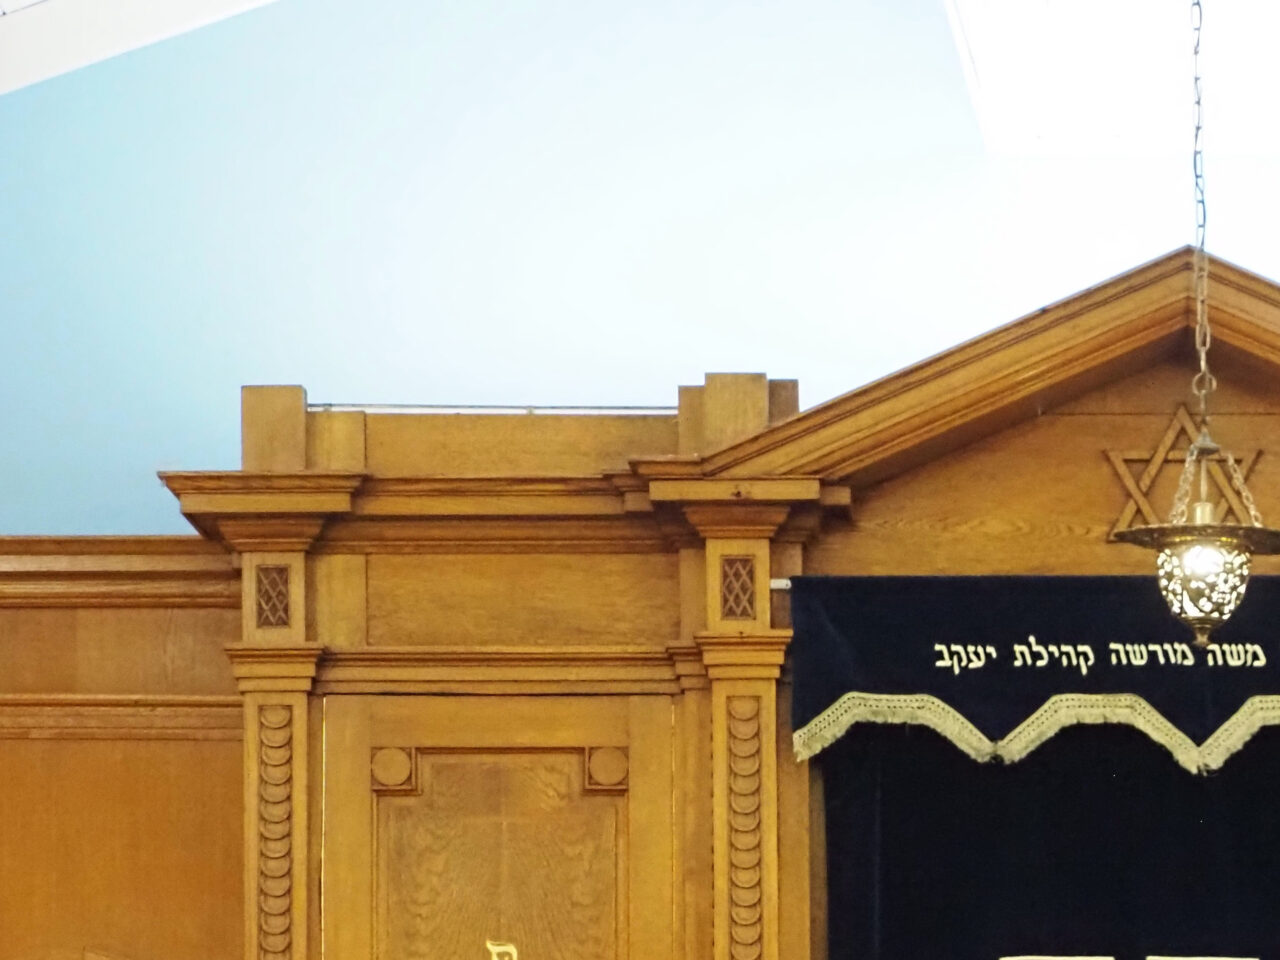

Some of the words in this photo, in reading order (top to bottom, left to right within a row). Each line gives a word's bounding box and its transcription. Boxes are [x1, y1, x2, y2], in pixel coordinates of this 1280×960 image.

[933, 642, 998, 676] יעקב
[1013, 634, 1096, 676] קהילת
[1108, 641, 1195, 667] מורשה
[1206, 642, 1267, 667] משה
